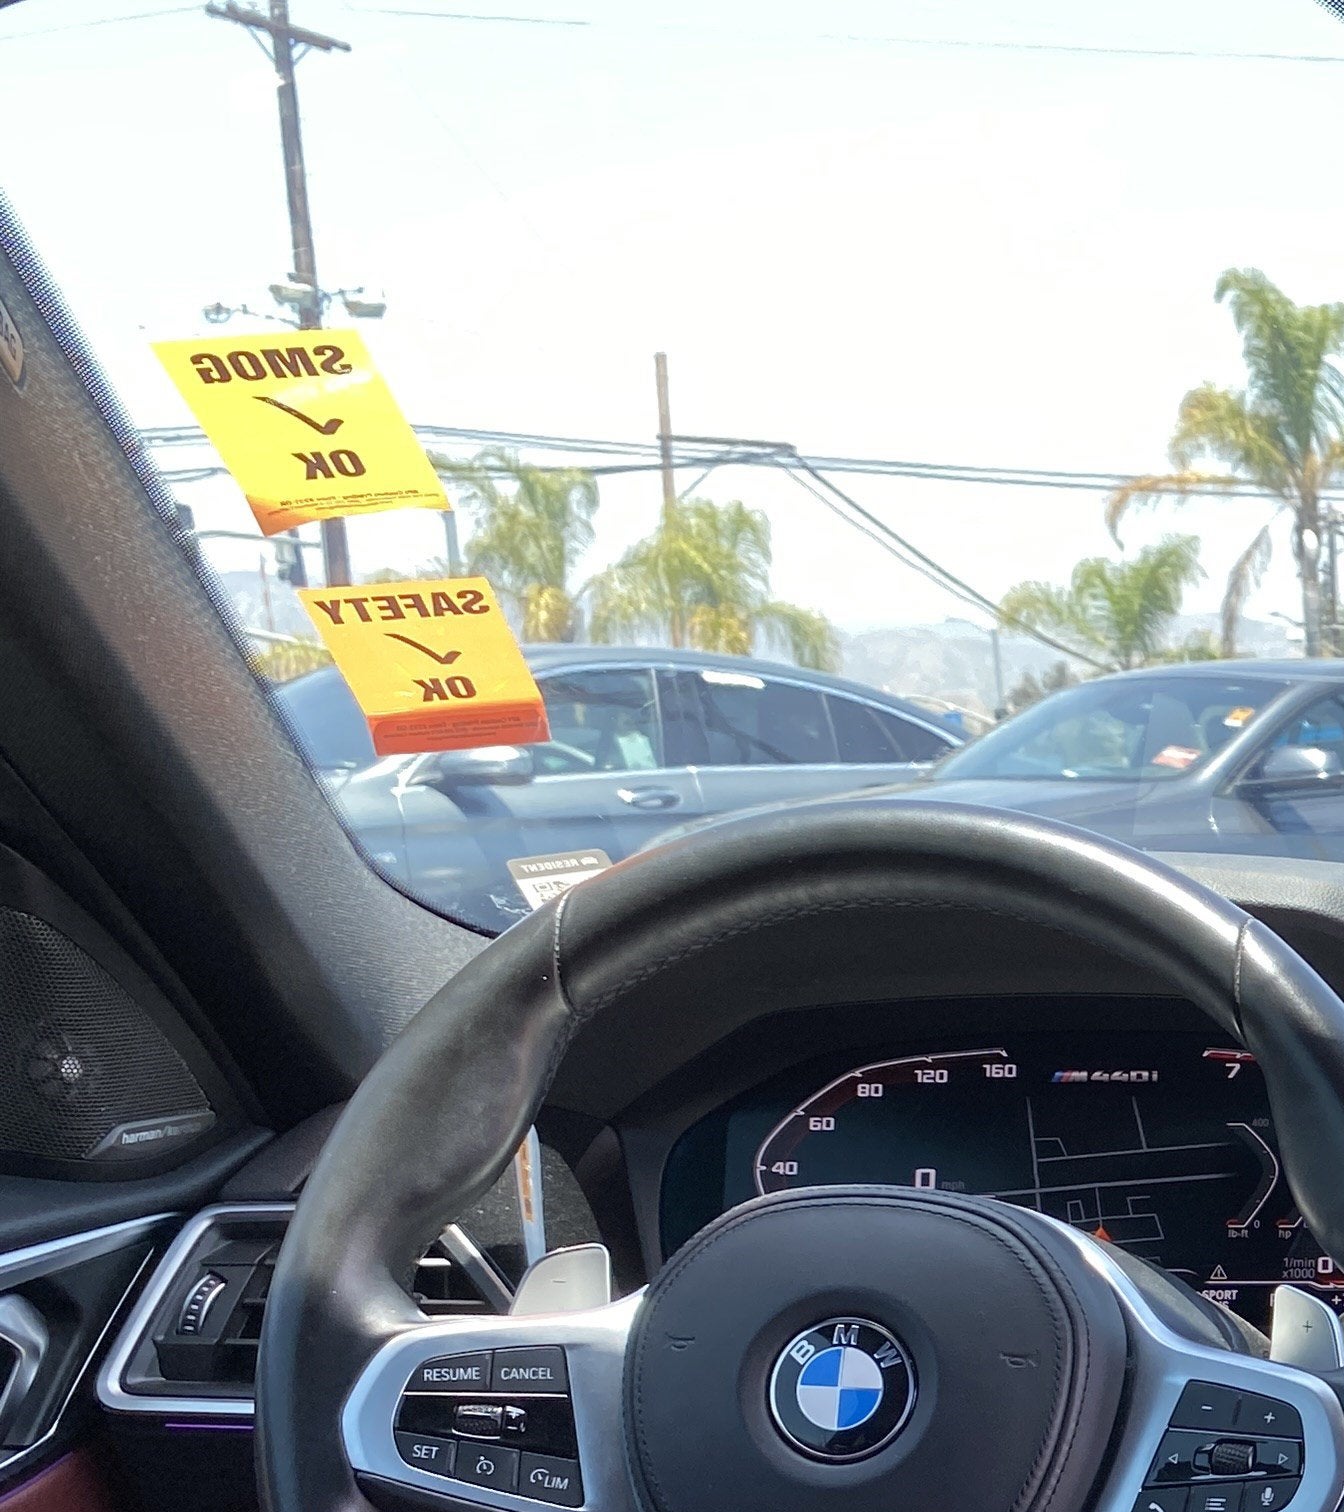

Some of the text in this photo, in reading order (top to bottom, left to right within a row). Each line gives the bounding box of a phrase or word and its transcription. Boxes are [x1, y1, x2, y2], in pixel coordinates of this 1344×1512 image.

[914, 1070, 948, 1083] 120
[983, 1064, 1017, 1078] 160
[1225, 1063, 1241, 1079] 7
[857, 1083, 883, 1097] 80
[809, 1117, 835, 1131] 60
[771, 1161, 798, 1175] 40
[915, 1168, 965, 1191] 0 mph
[1228, 1229, 1248, 1238] lb-ft
[1278, 1229, 1291, 1240] hp
[1283, 1256, 1333, 1274] 1/min 0
[1282, 1268, 1315, 1279] x1000
[1202, 1290, 1238, 1300] SPORT
[790, 1324, 902, 1369] BMW
[423, 1367, 481, 1382] RESUME
[501, 1367, 554, 1380] CANCEL
[412, 1445, 439, 1459] SET
[544, 1475, 569, 1490] LIM
